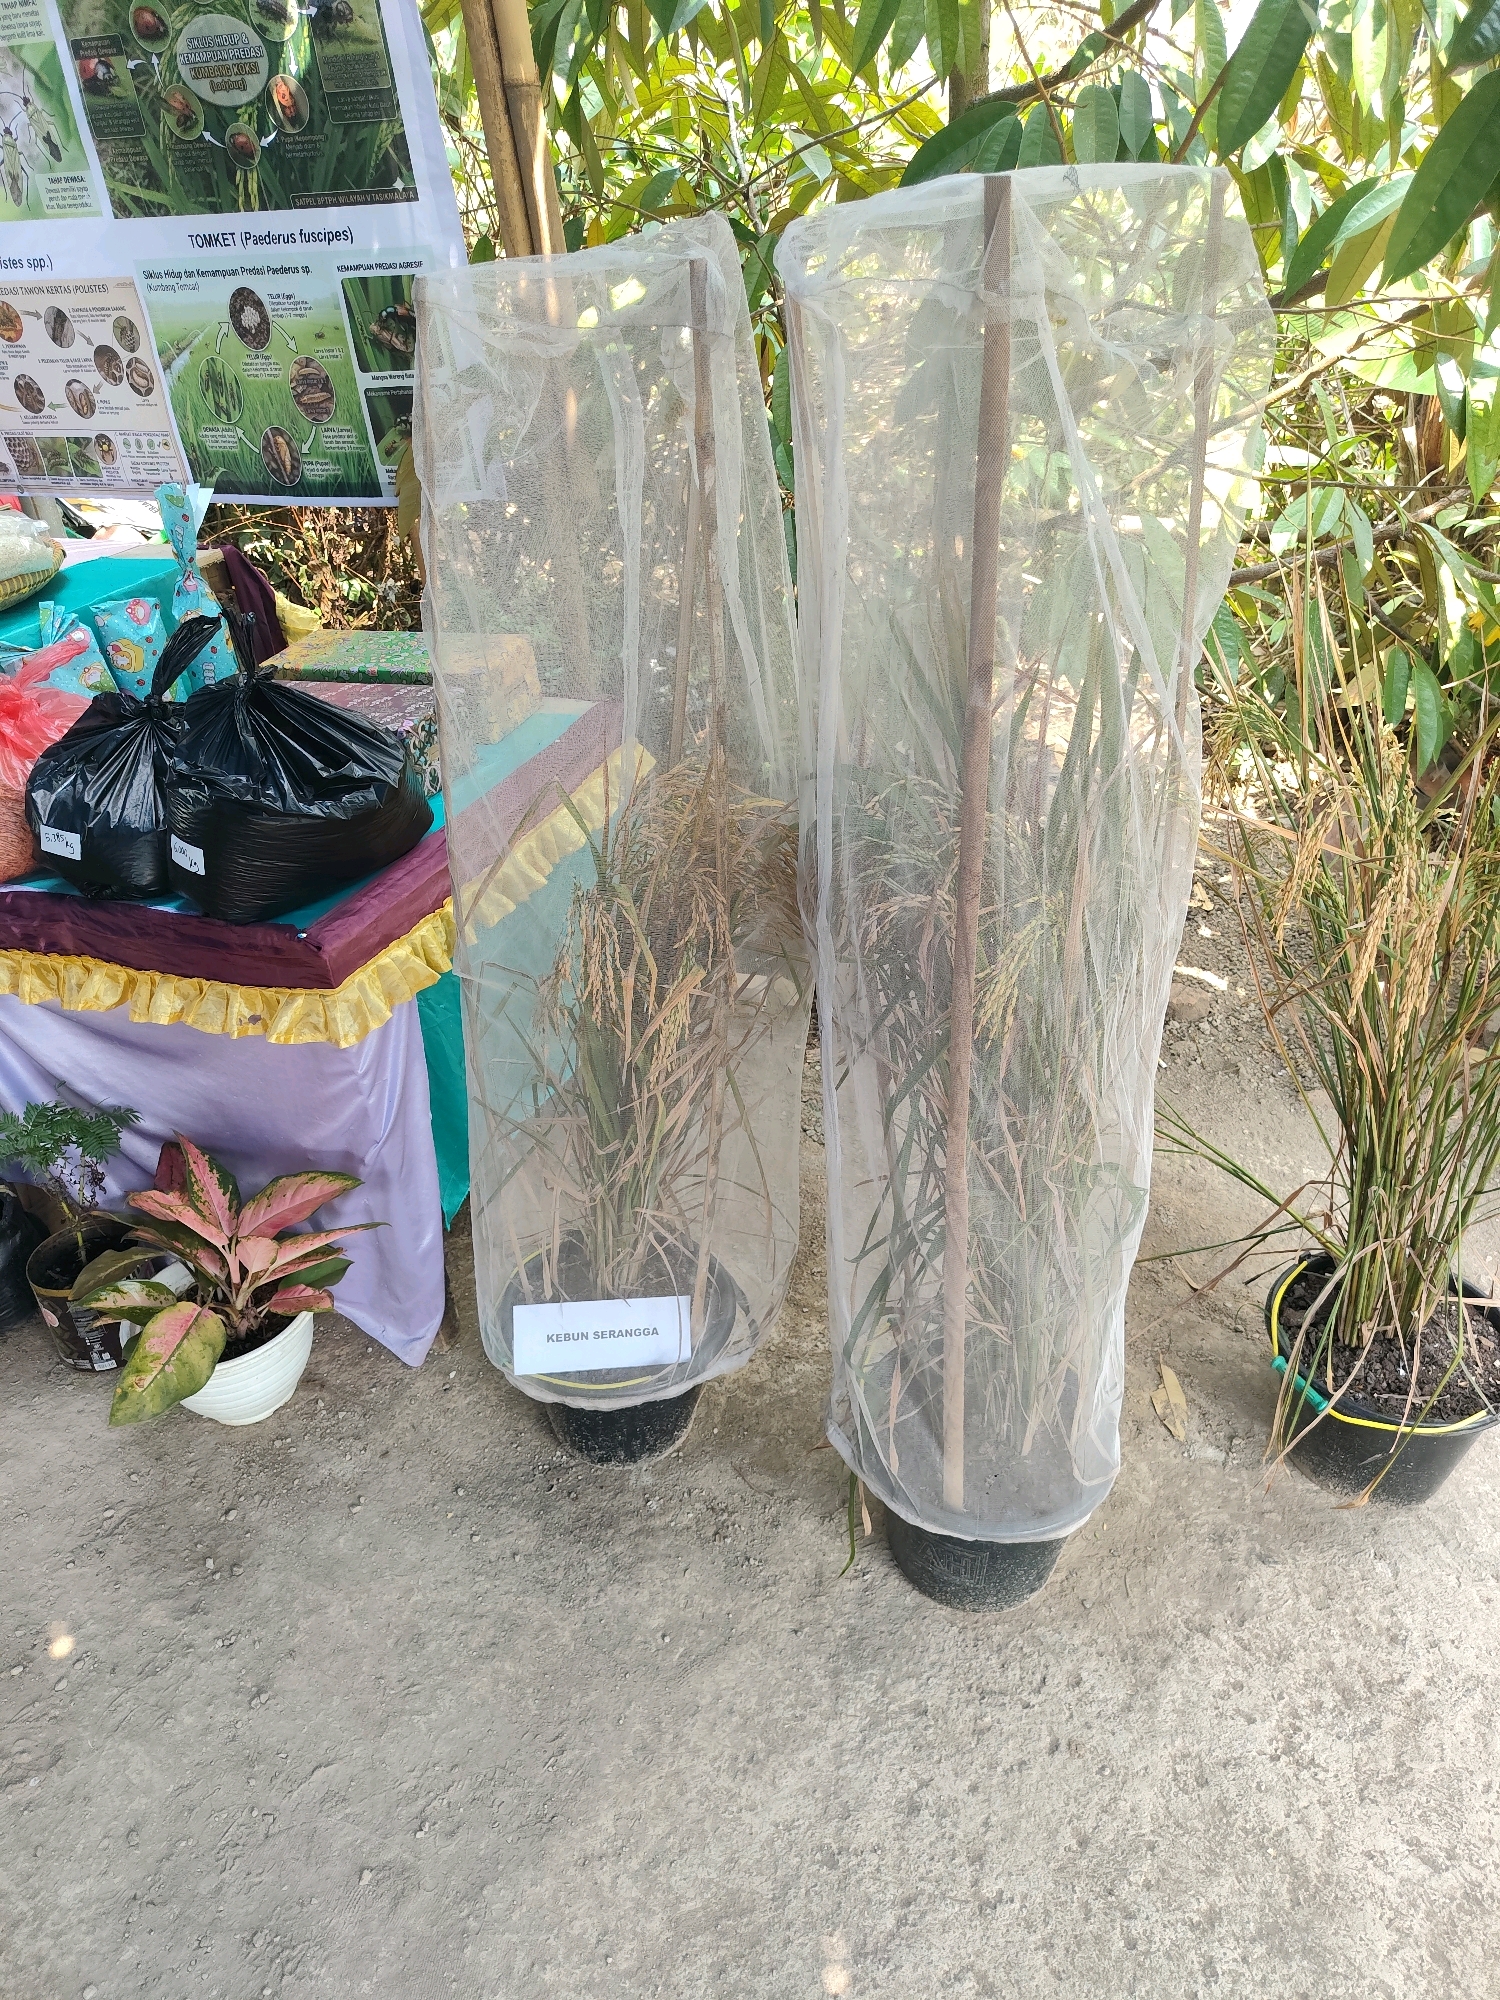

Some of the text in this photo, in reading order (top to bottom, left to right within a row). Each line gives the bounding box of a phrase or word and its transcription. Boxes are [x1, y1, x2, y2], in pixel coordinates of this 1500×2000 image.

[186, 33, 249, 49] SIKLUS HIDUP &
[180, 46, 264, 65] KEMAMPUAN PREDASI
[189, 62, 260, 79] KUMBANG KOKSI
[209, 78, 248, 93] (Ladybug)
[339, 194, 366, 204] WILAYAH
[188, 226, 354, 250] TOMKET (Paederus fuscipes)
[26, 253, 53, 272] spp.)
[336, 262, 374, 273] KEMAMPUAN
[375, 261, 398, 271] PREDASI
[142, 265, 313, 281] Siklus Hidup dan Kemampuan Predasi Paederus sp.
[0, 283, 109, 296] EDASI TAWON KERTAS (POLISTES)
[146, 282, 176, 294] (Kumbang
[546, 1327, 660, 1344] KEBUN SERANGGA
